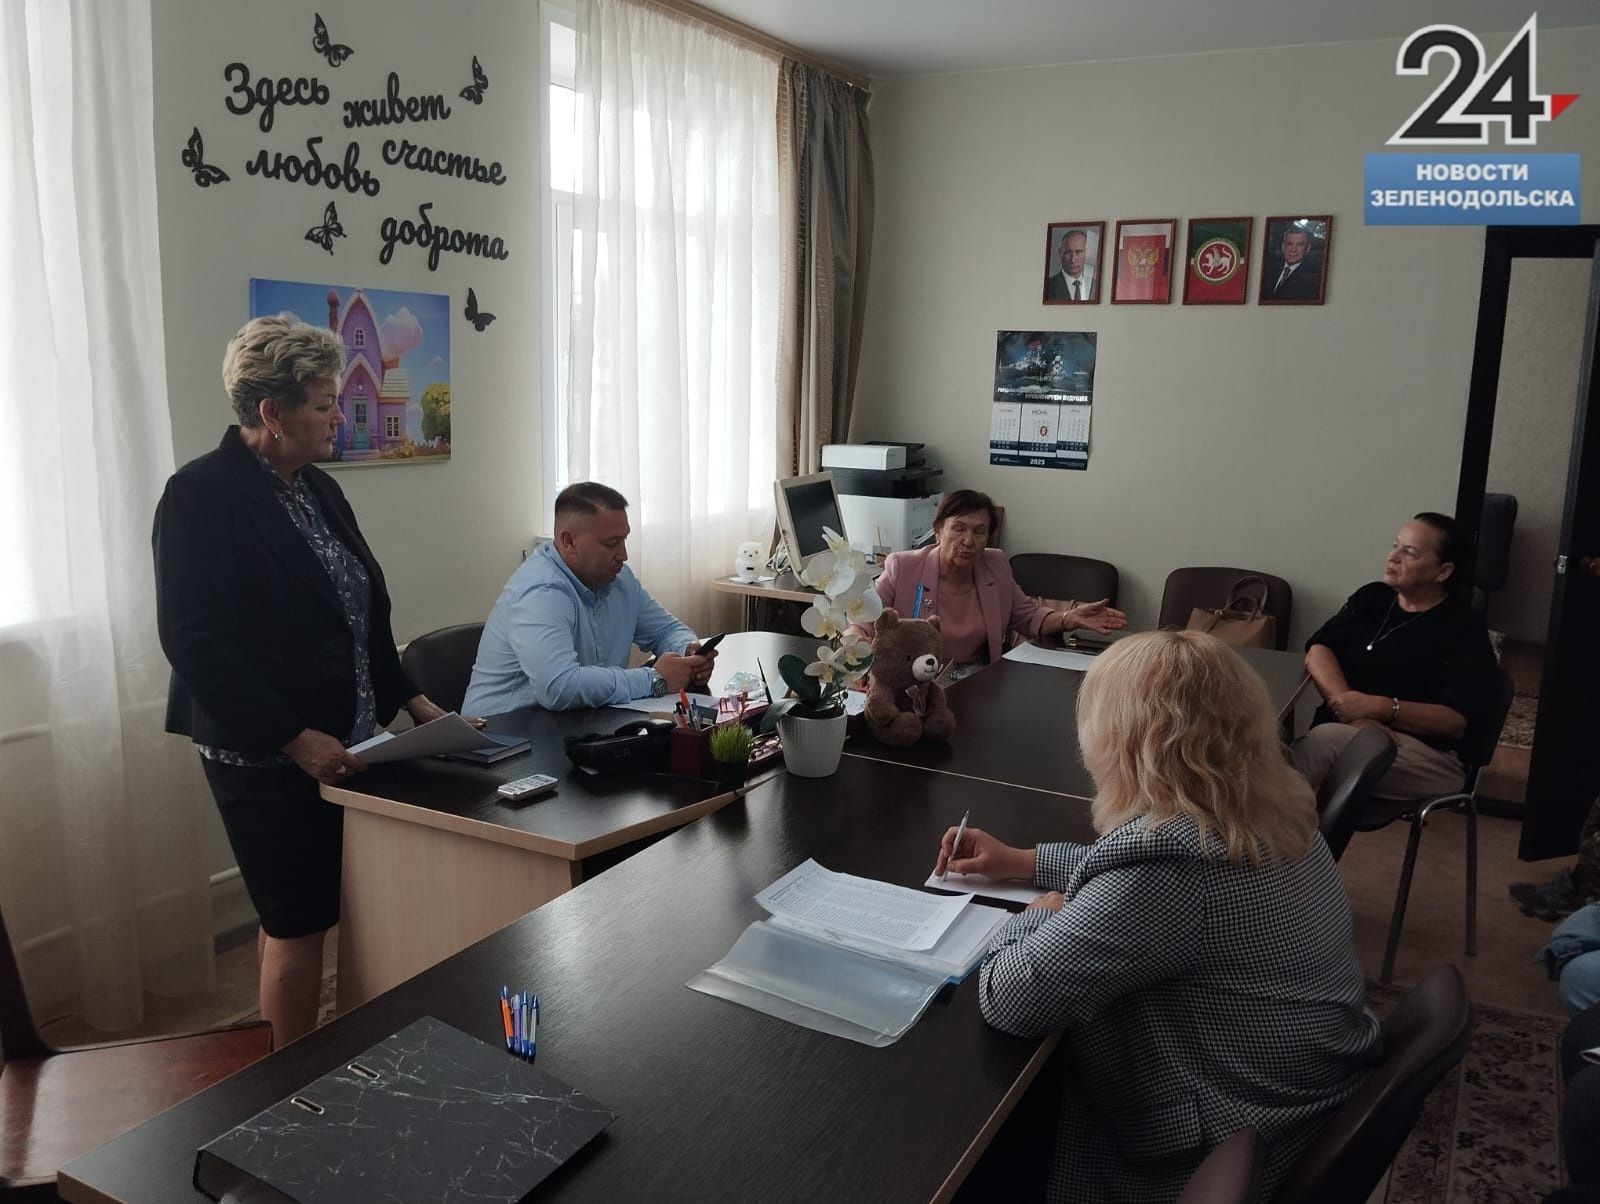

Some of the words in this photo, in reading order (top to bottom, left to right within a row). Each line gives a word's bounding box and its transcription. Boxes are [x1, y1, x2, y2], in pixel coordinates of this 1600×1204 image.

[224, 62, 330, 133] Здесь
[343, 72, 451, 129] живет
[246, 136, 380, 197] любовь
[382, 139, 507, 186] счастье
[380, 202, 509, 272] доброта
[1030, 458, 1046, 466] 2025
